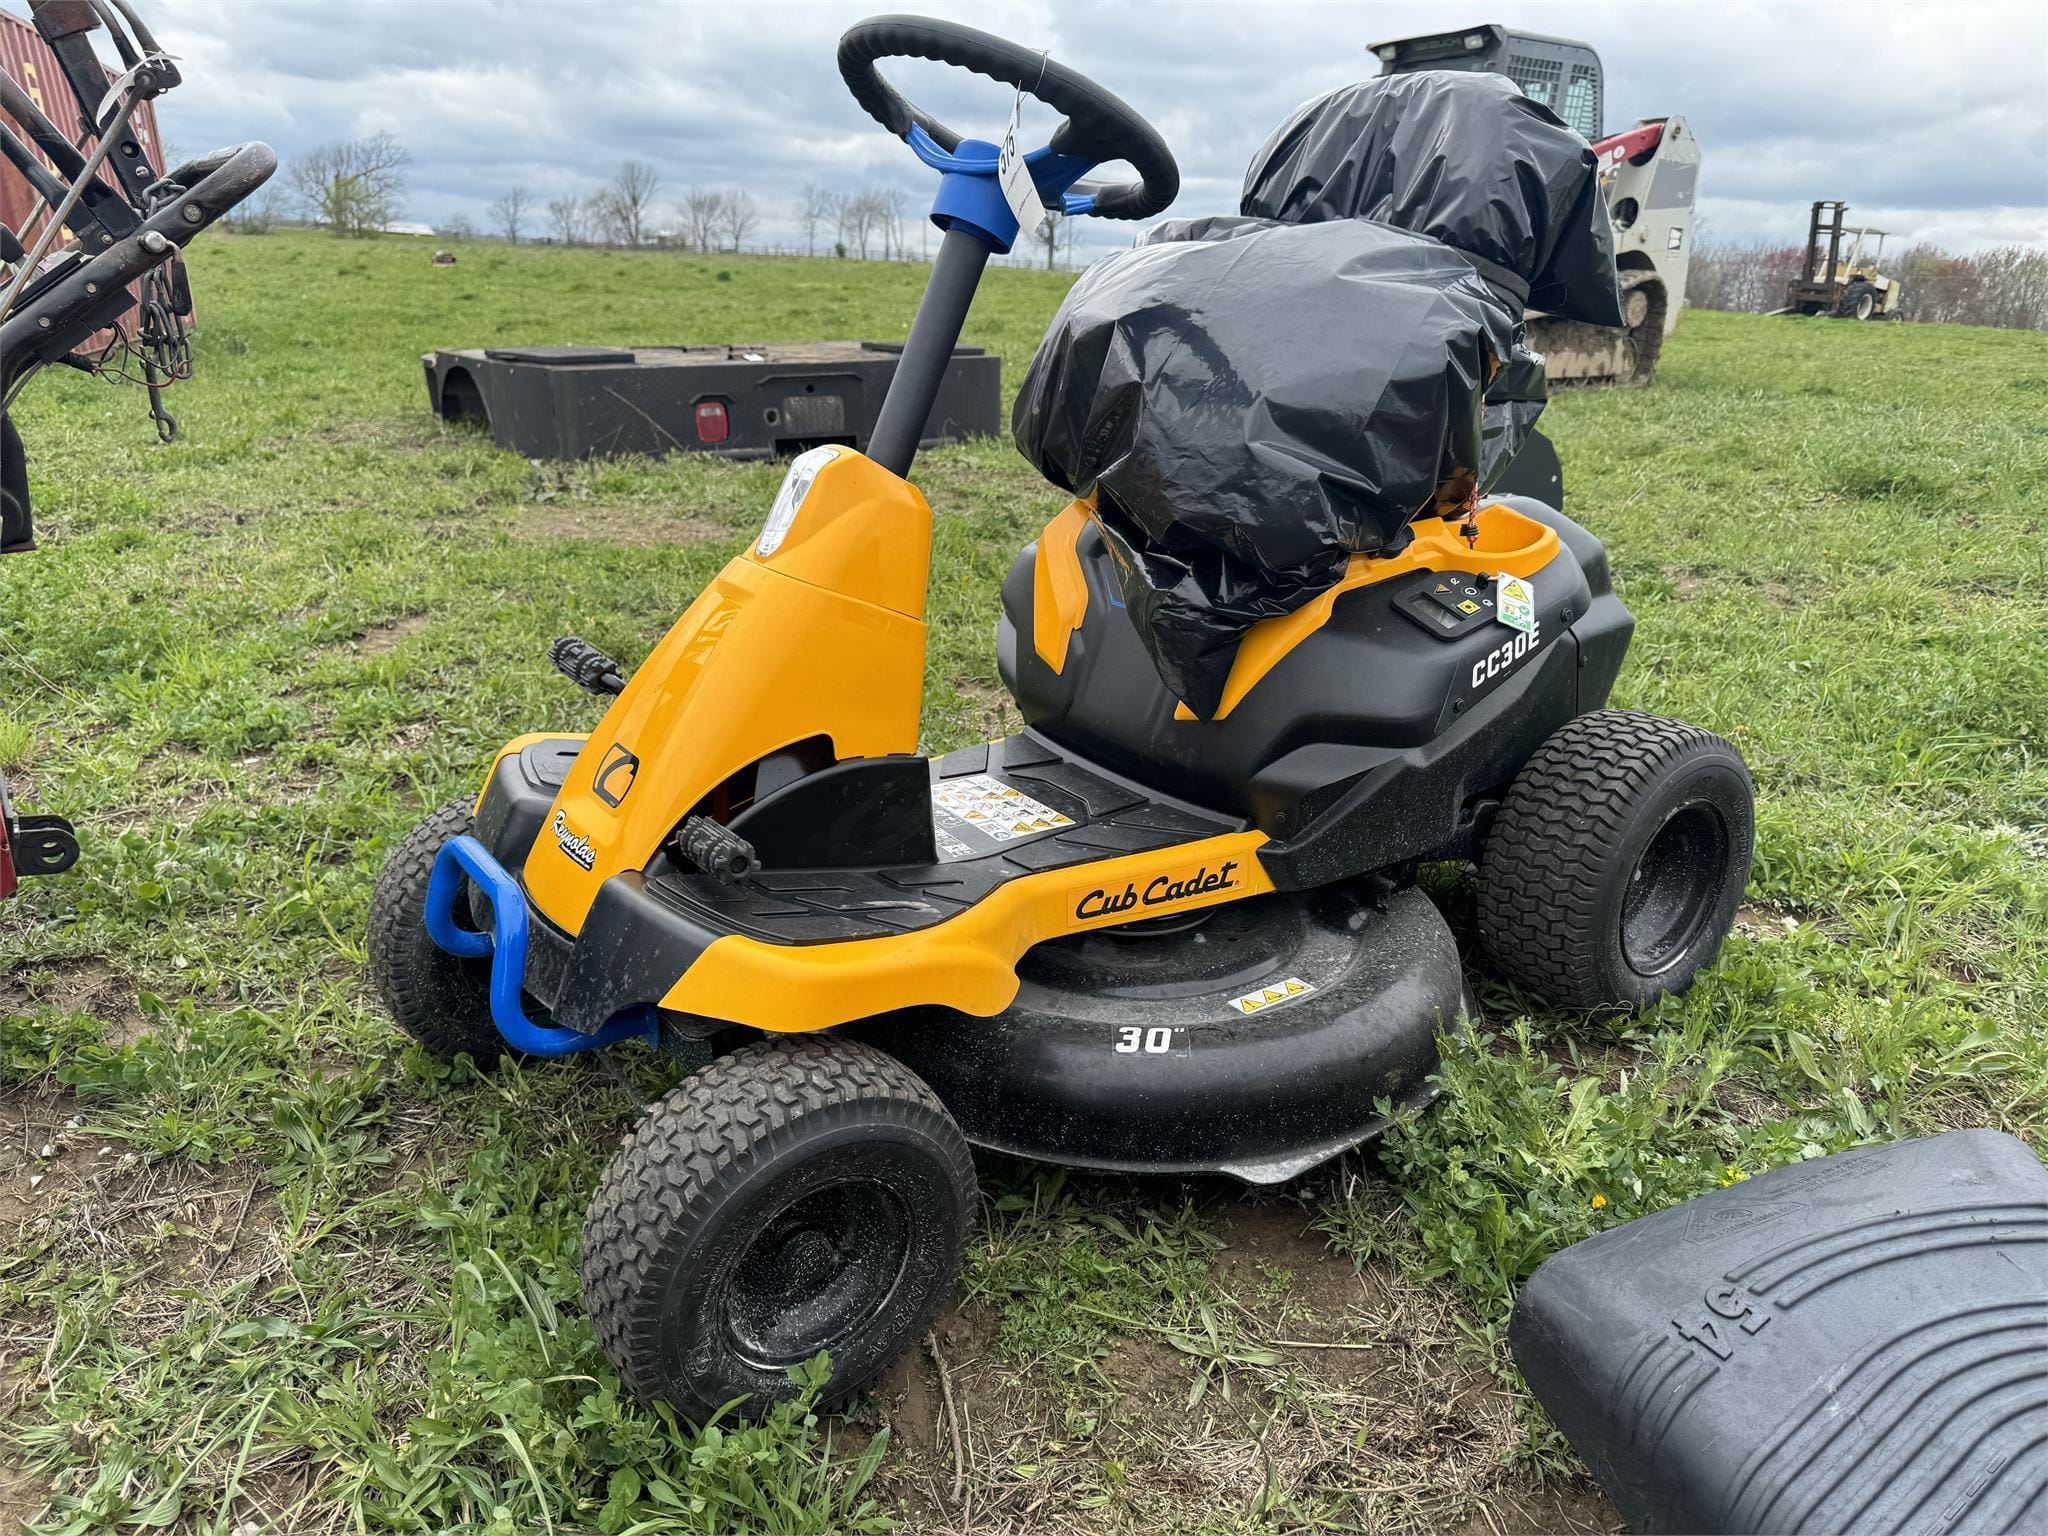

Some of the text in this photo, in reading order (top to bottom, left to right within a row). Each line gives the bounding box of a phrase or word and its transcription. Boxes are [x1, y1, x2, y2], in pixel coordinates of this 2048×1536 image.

[1472, 620, 1540, 689] CC30E
[1075, 861, 1239, 920] Cub Cadet
[1115, 1026, 1185, 1054] 30"
[1670, 1283, 1772, 1361] 54
